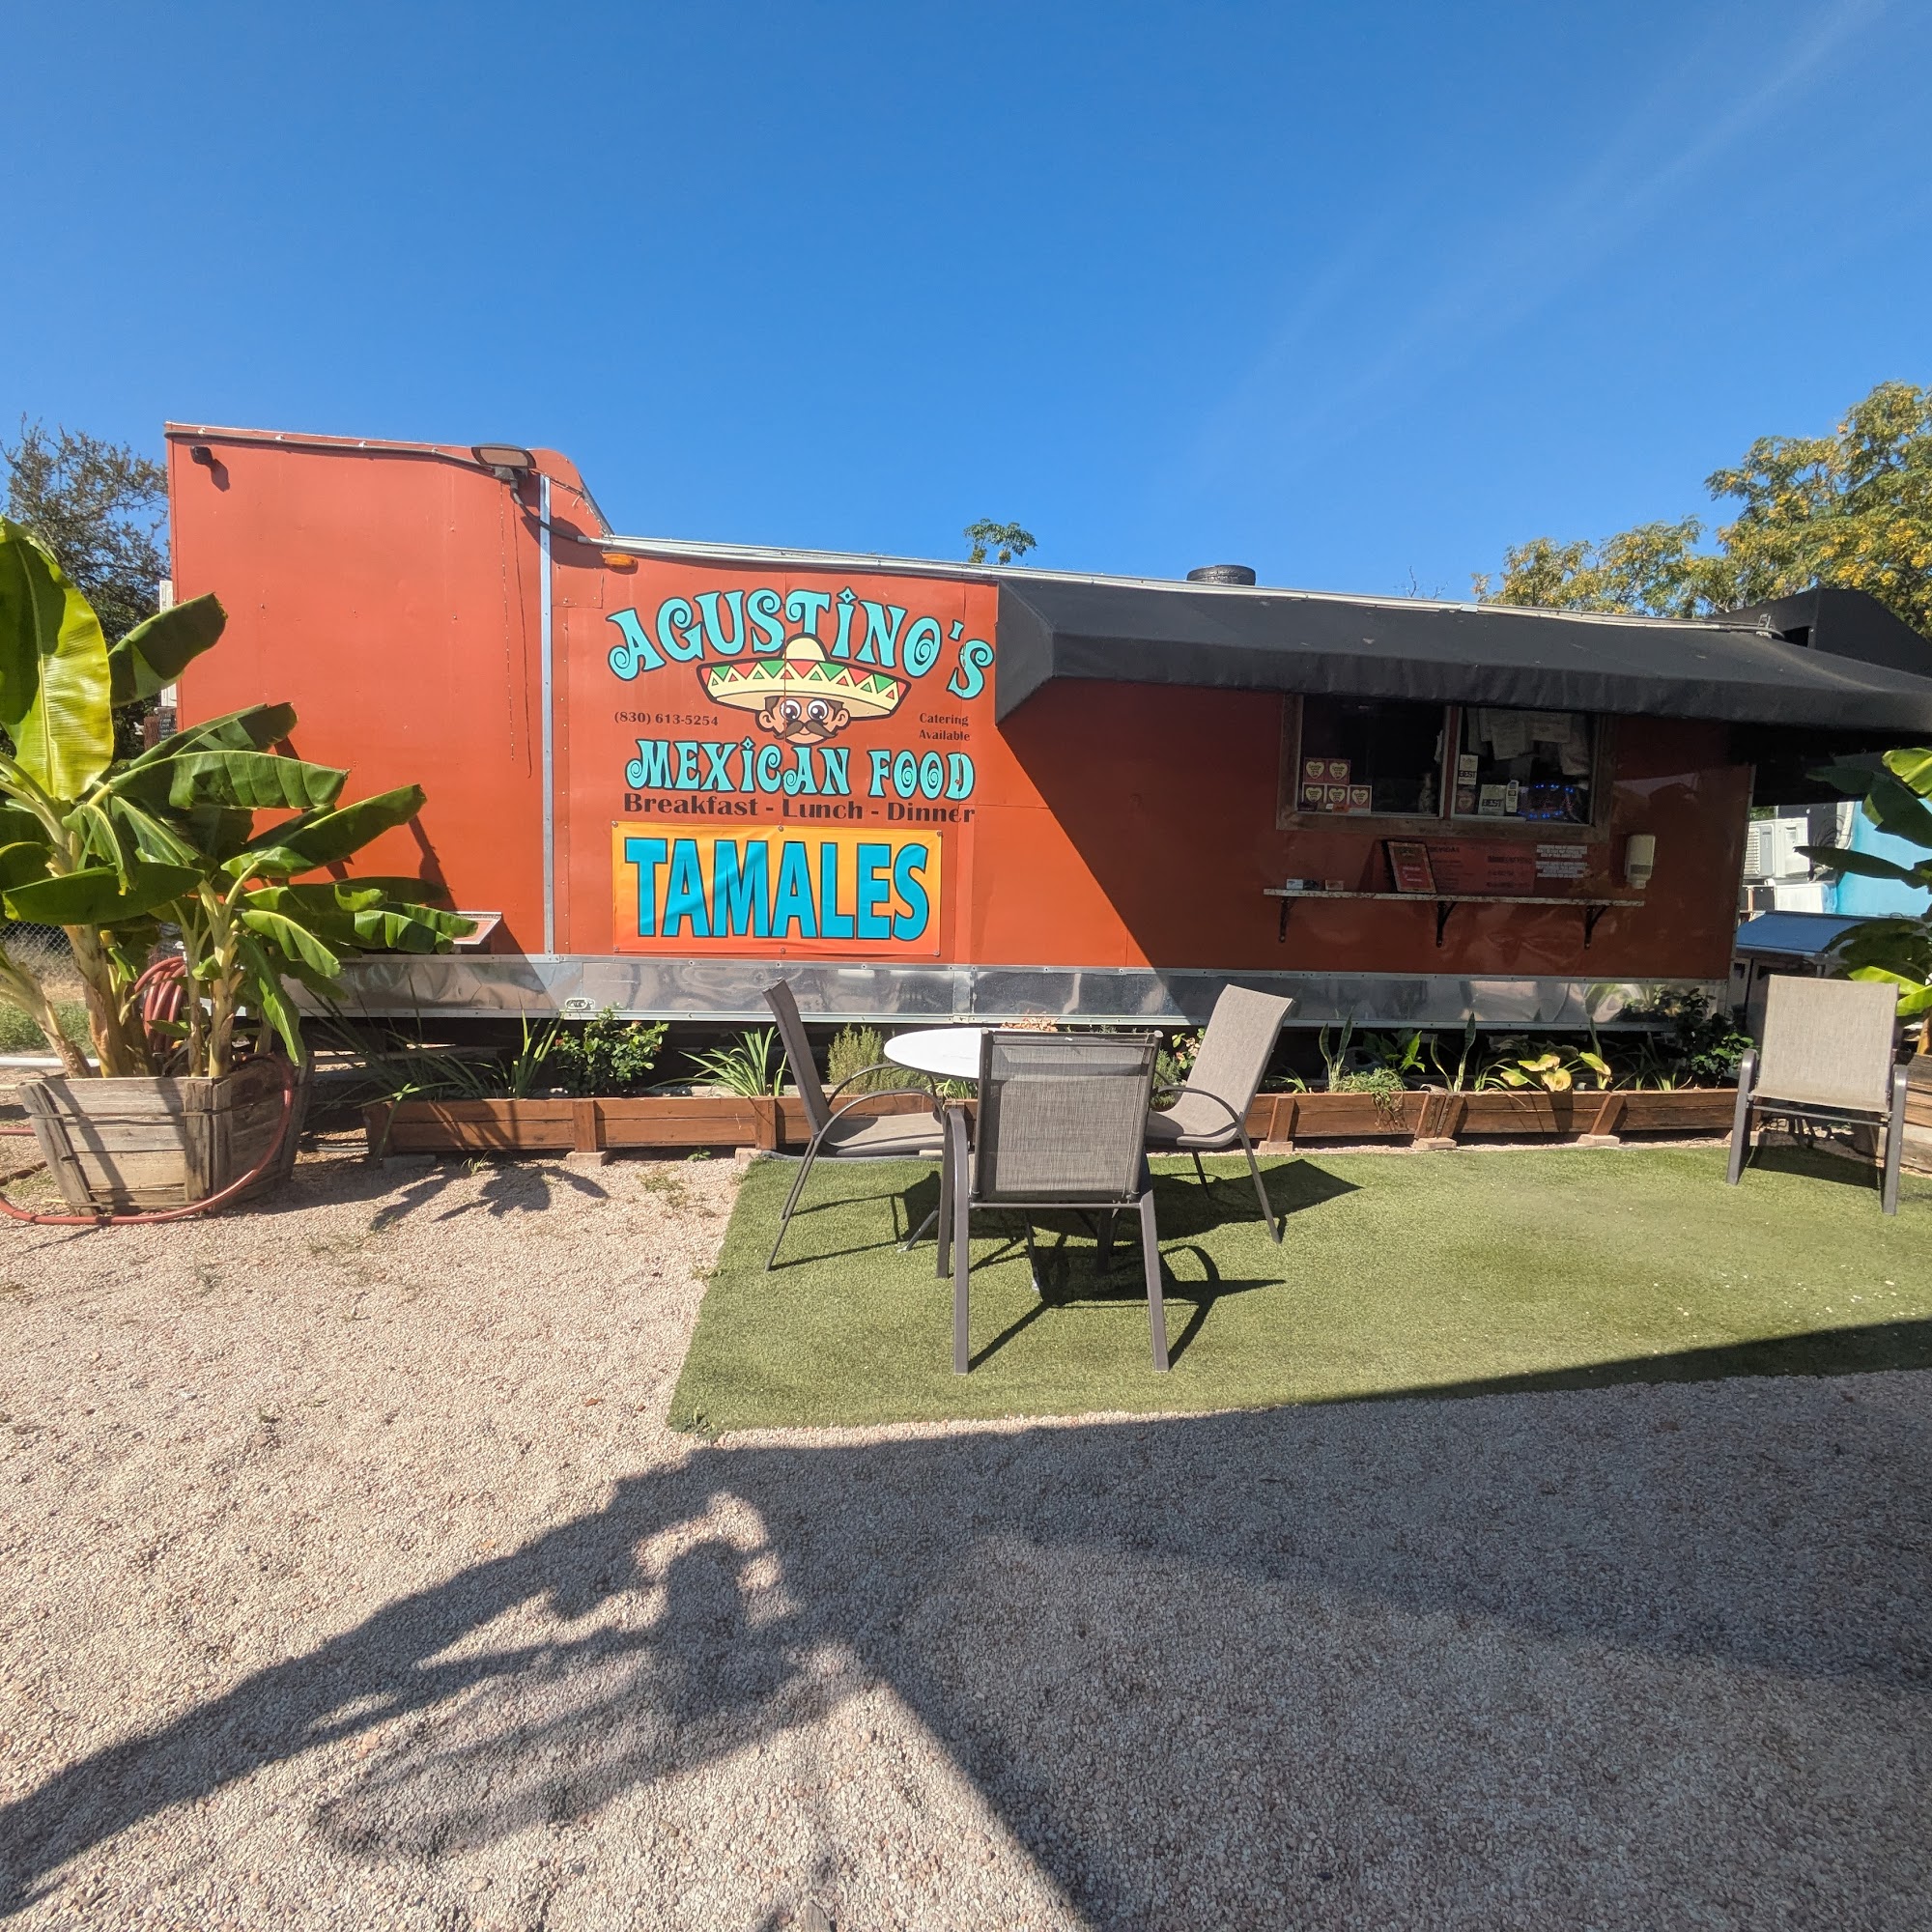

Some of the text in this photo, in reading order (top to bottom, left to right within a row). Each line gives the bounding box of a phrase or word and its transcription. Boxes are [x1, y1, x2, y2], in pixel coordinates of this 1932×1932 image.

[607, 586, 995, 699] AGUSTINO'S
[614, 711, 719, 725] (830) 613-5254
[920, 713, 969, 726] Catering
[919, 729, 970, 741] Available
[625, 736, 976, 801] MEXICAN FOOD
[624, 793, 758, 817] Breakfast
[782, 798, 863, 819] Lunch
[888, 802, 976, 823] Dinner
[624, 837, 929, 942] TAMALES
